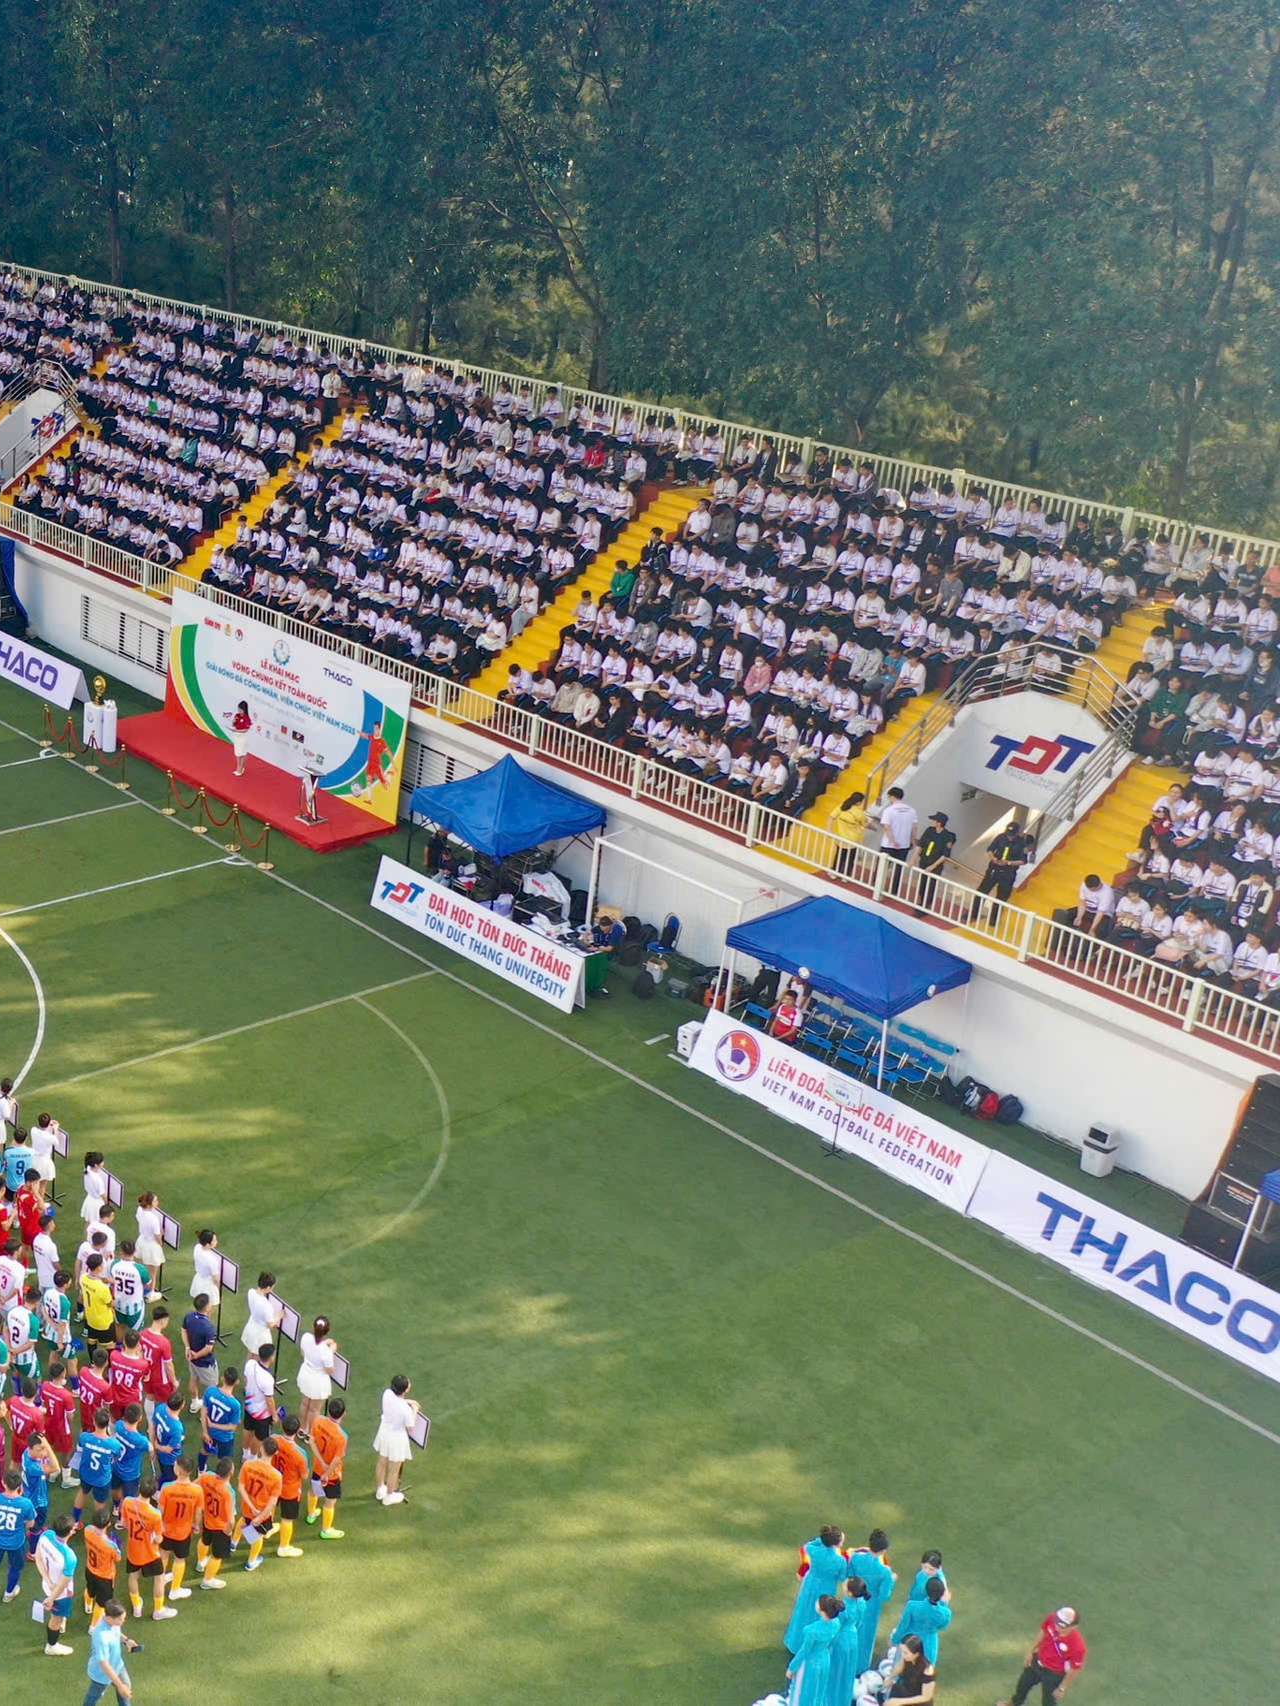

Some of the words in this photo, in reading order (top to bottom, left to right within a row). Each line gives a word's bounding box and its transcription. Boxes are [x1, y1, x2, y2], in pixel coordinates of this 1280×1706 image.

[268, 665, 284, 677] KHAI
[323, 667, 353, 686] THACO
[251, 669, 274, 686] CHUNG
[287, 684, 306, 700] TOÀN
[325, 716, 340, 728] NAM
[341, 722, 356, 735] 2025
[985, 734, 1097, 775] TDT
[379, 880, 425, 904] TDT
[427, 892, 448, 917] ĐẠI
[450, 906, 474, 930] HỌC
[477, 917, 501, 944] TÔN
[501, 930, 528, 957] ĐỨC
[529, 945, 572, 982] THẮNG
[423, 913, 444, 934] TON
[447, 924, 466, 946] DUC
[468, 936, 503, 967] THANG
[504, 956, 567, 1000] UNIVERSITY
[767, 1056, 797, 1083] LIÊN
[872, 1108, 894, 1133] ĐÁ
[894, 1119, 928, 1149] VIỆT
[927, 1138, 963, 1169] NAM
[761, 1075, 787, 1097] VIET
[788, 1089, 816, 1112] NAM
[817, 1105, 876, 1145] FOOTBALL
[878, 1136, 954, 1185] FEDERATION
[1, 1275, 8, 1290] 3
[1035, 1190, 1280, 1355] THACO
[114, 1276, 135, 1296] 35
[11, 1326, 20, 1344] 2
[114, 1371, 135, 1388] 98
[79, 1385, 95, 1404] 29
[210, 1404, 224, 1423] 17
[12, 1414, 25, 1435] 17
[89, 1452, 102, 1471] 5
[248, 1477, 265, 1498] 17
[129, 1520, 144, 1542] 12
